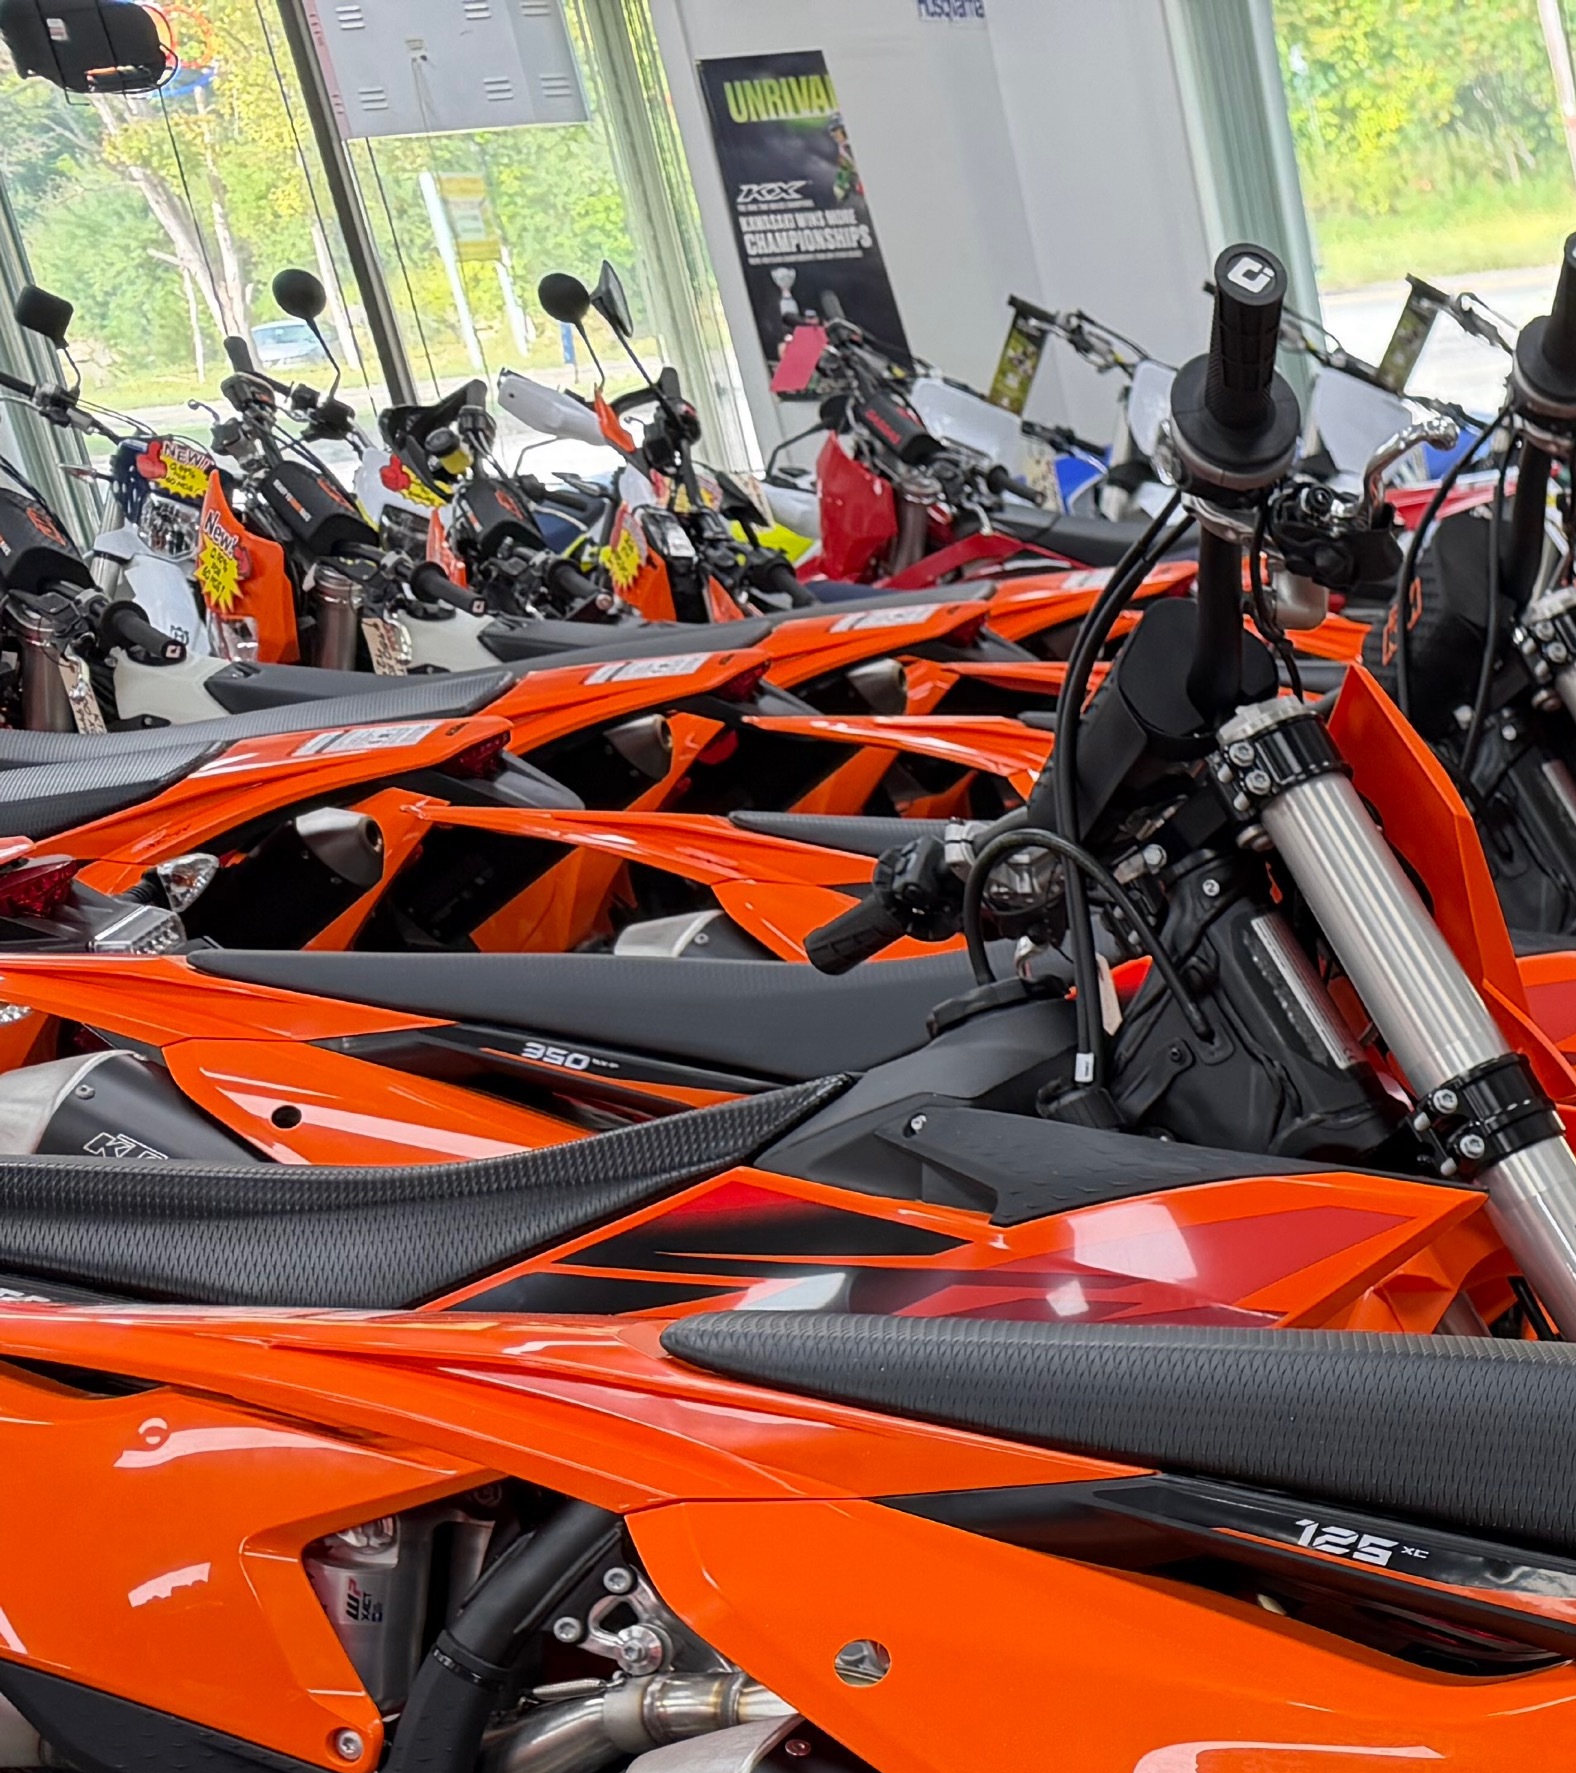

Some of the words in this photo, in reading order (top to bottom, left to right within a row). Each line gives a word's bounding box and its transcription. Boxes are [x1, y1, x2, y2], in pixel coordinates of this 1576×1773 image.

[744, 225, 873, 256] CHAMPIONSHIPS
[521, 1041, 591, 1070] 350
[83, 1132, 167, 1160] KT
[1295, 1518, 1400, 1567] 125
[1401, 1546, 1430, 1560] XC
